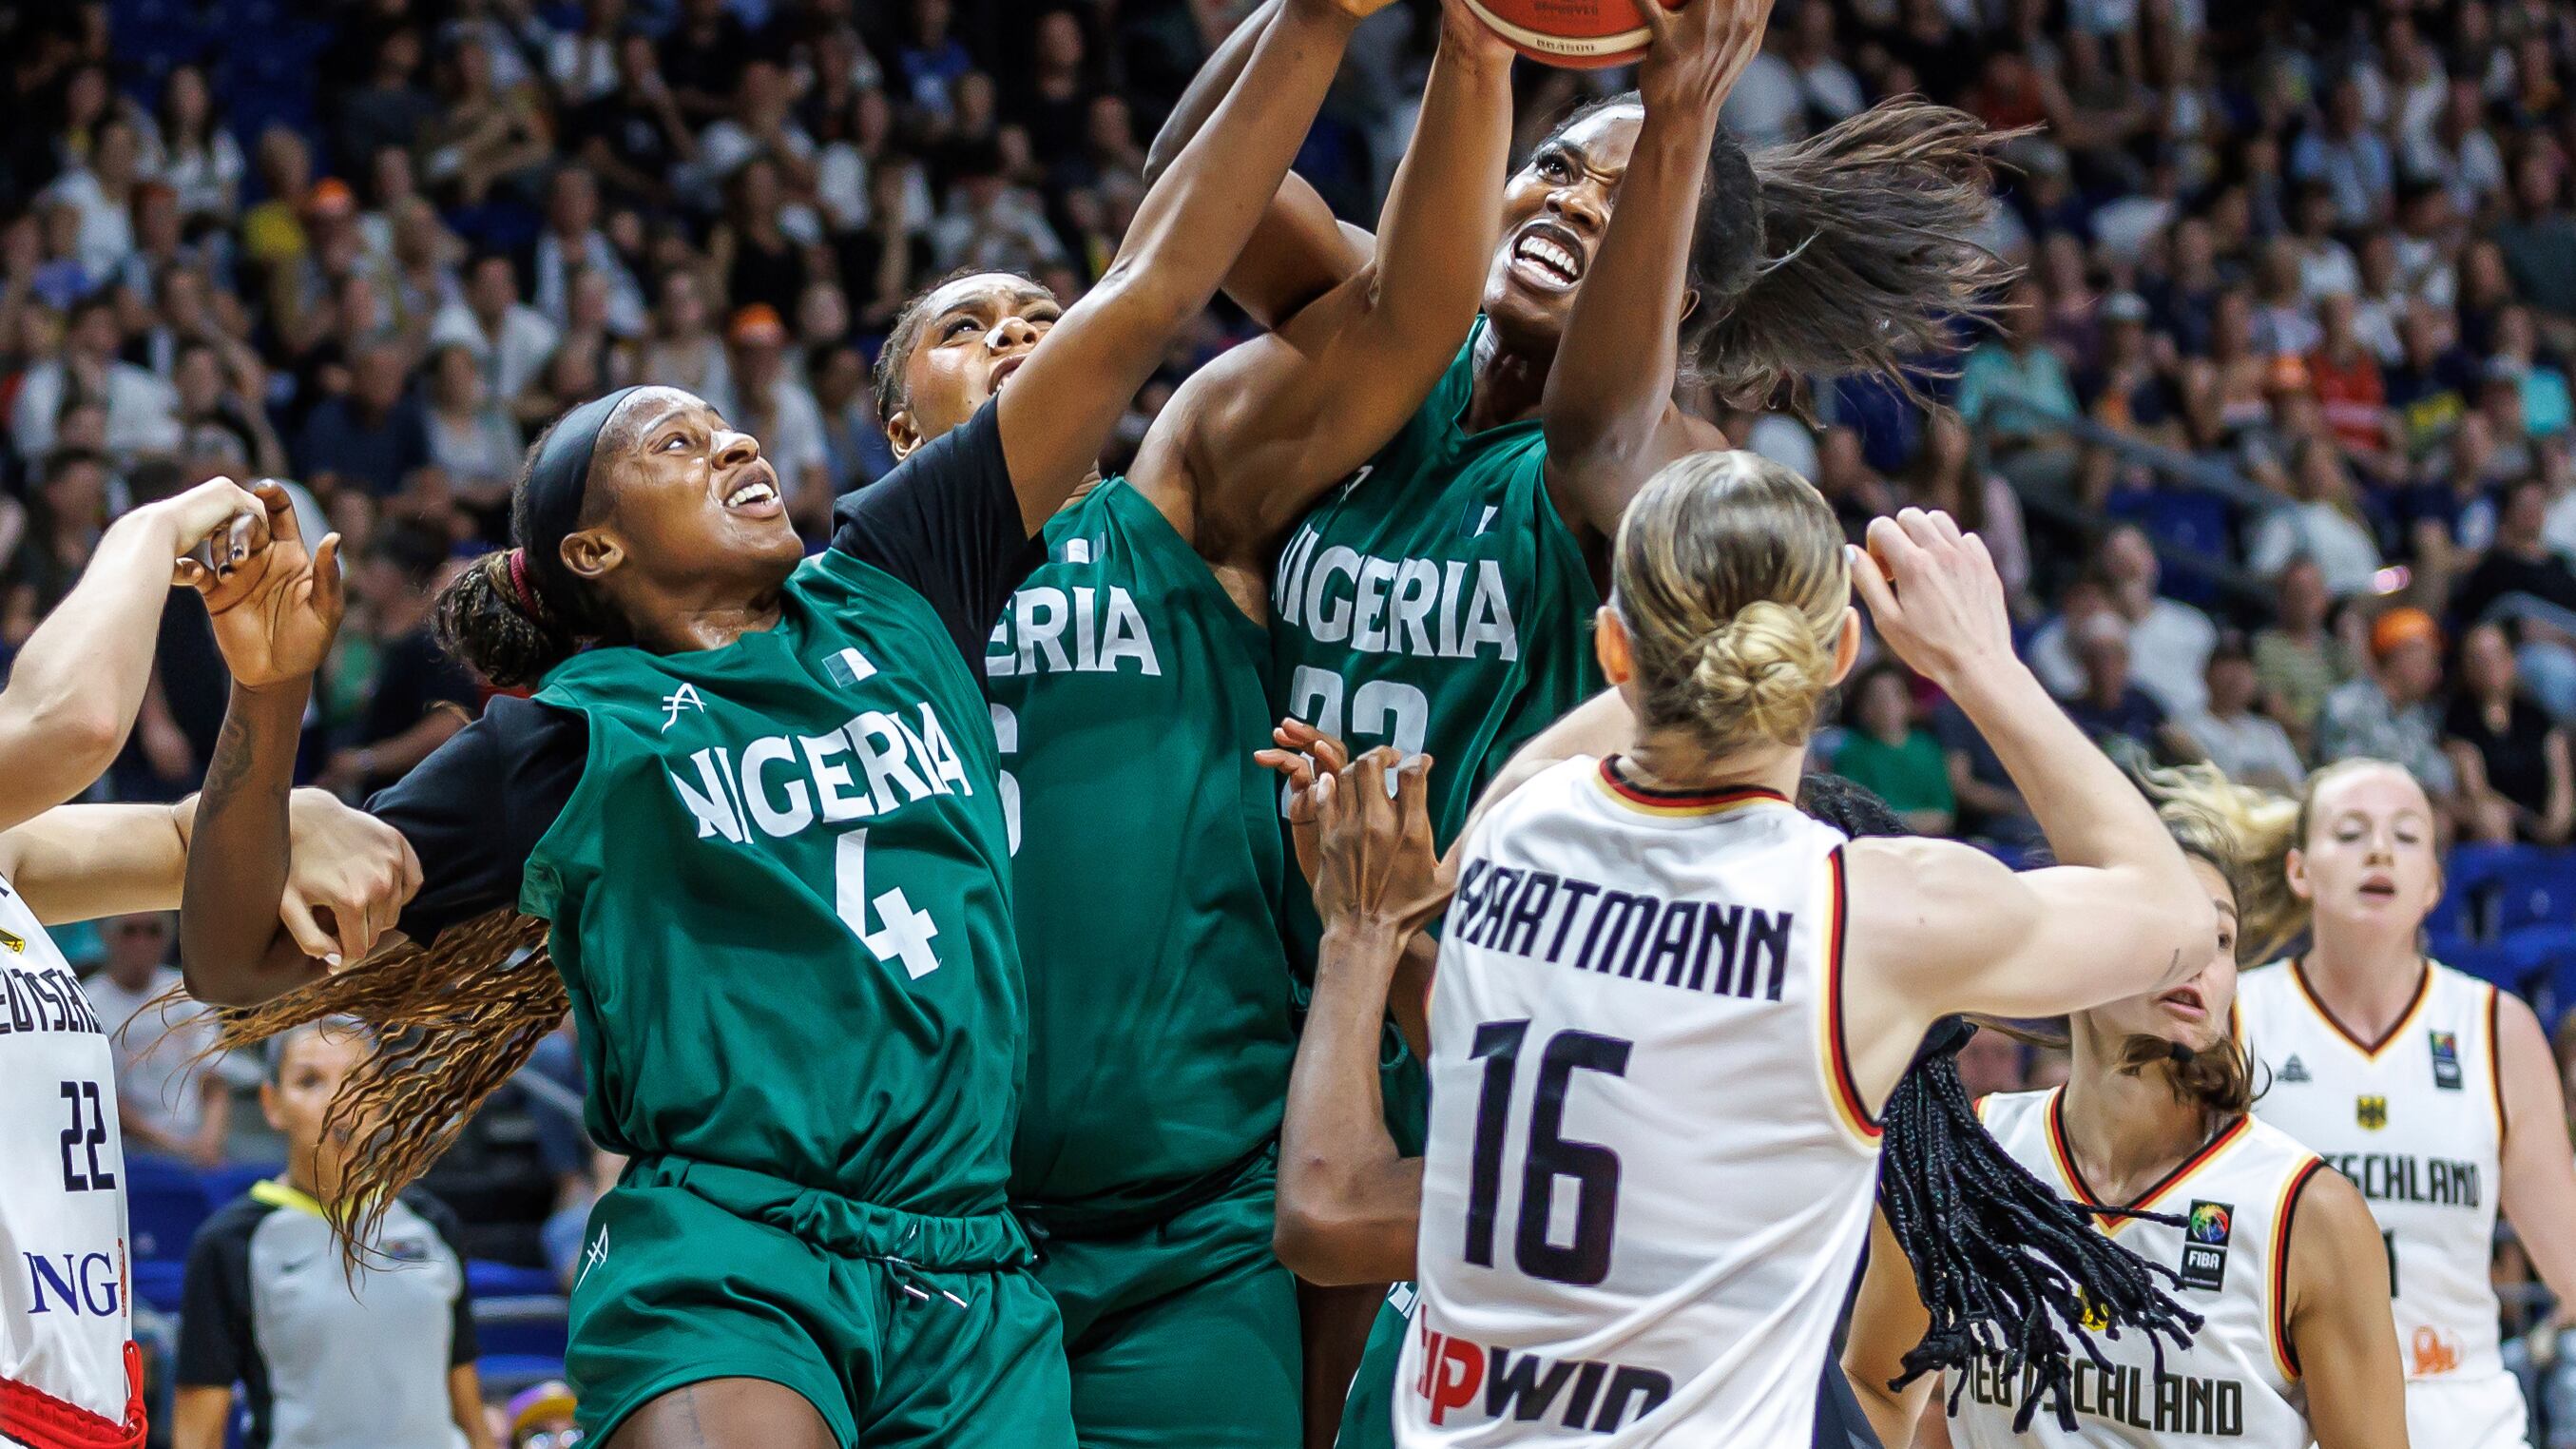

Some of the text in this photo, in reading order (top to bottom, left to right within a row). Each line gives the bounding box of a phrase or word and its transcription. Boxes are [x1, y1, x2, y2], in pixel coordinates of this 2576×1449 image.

[985, 585, 1162, 676] ERIA
[670, 702, 973, 844] NIGERIA
[836, 827, 941, 981] 4
[1454, 859, 1794, 1002] HARTMANN
[60, 1080, 117, 1192] 22
[1464, 1017, 1634, 1286] 16
[2188, 1249, 2220, 1271] FIBA
